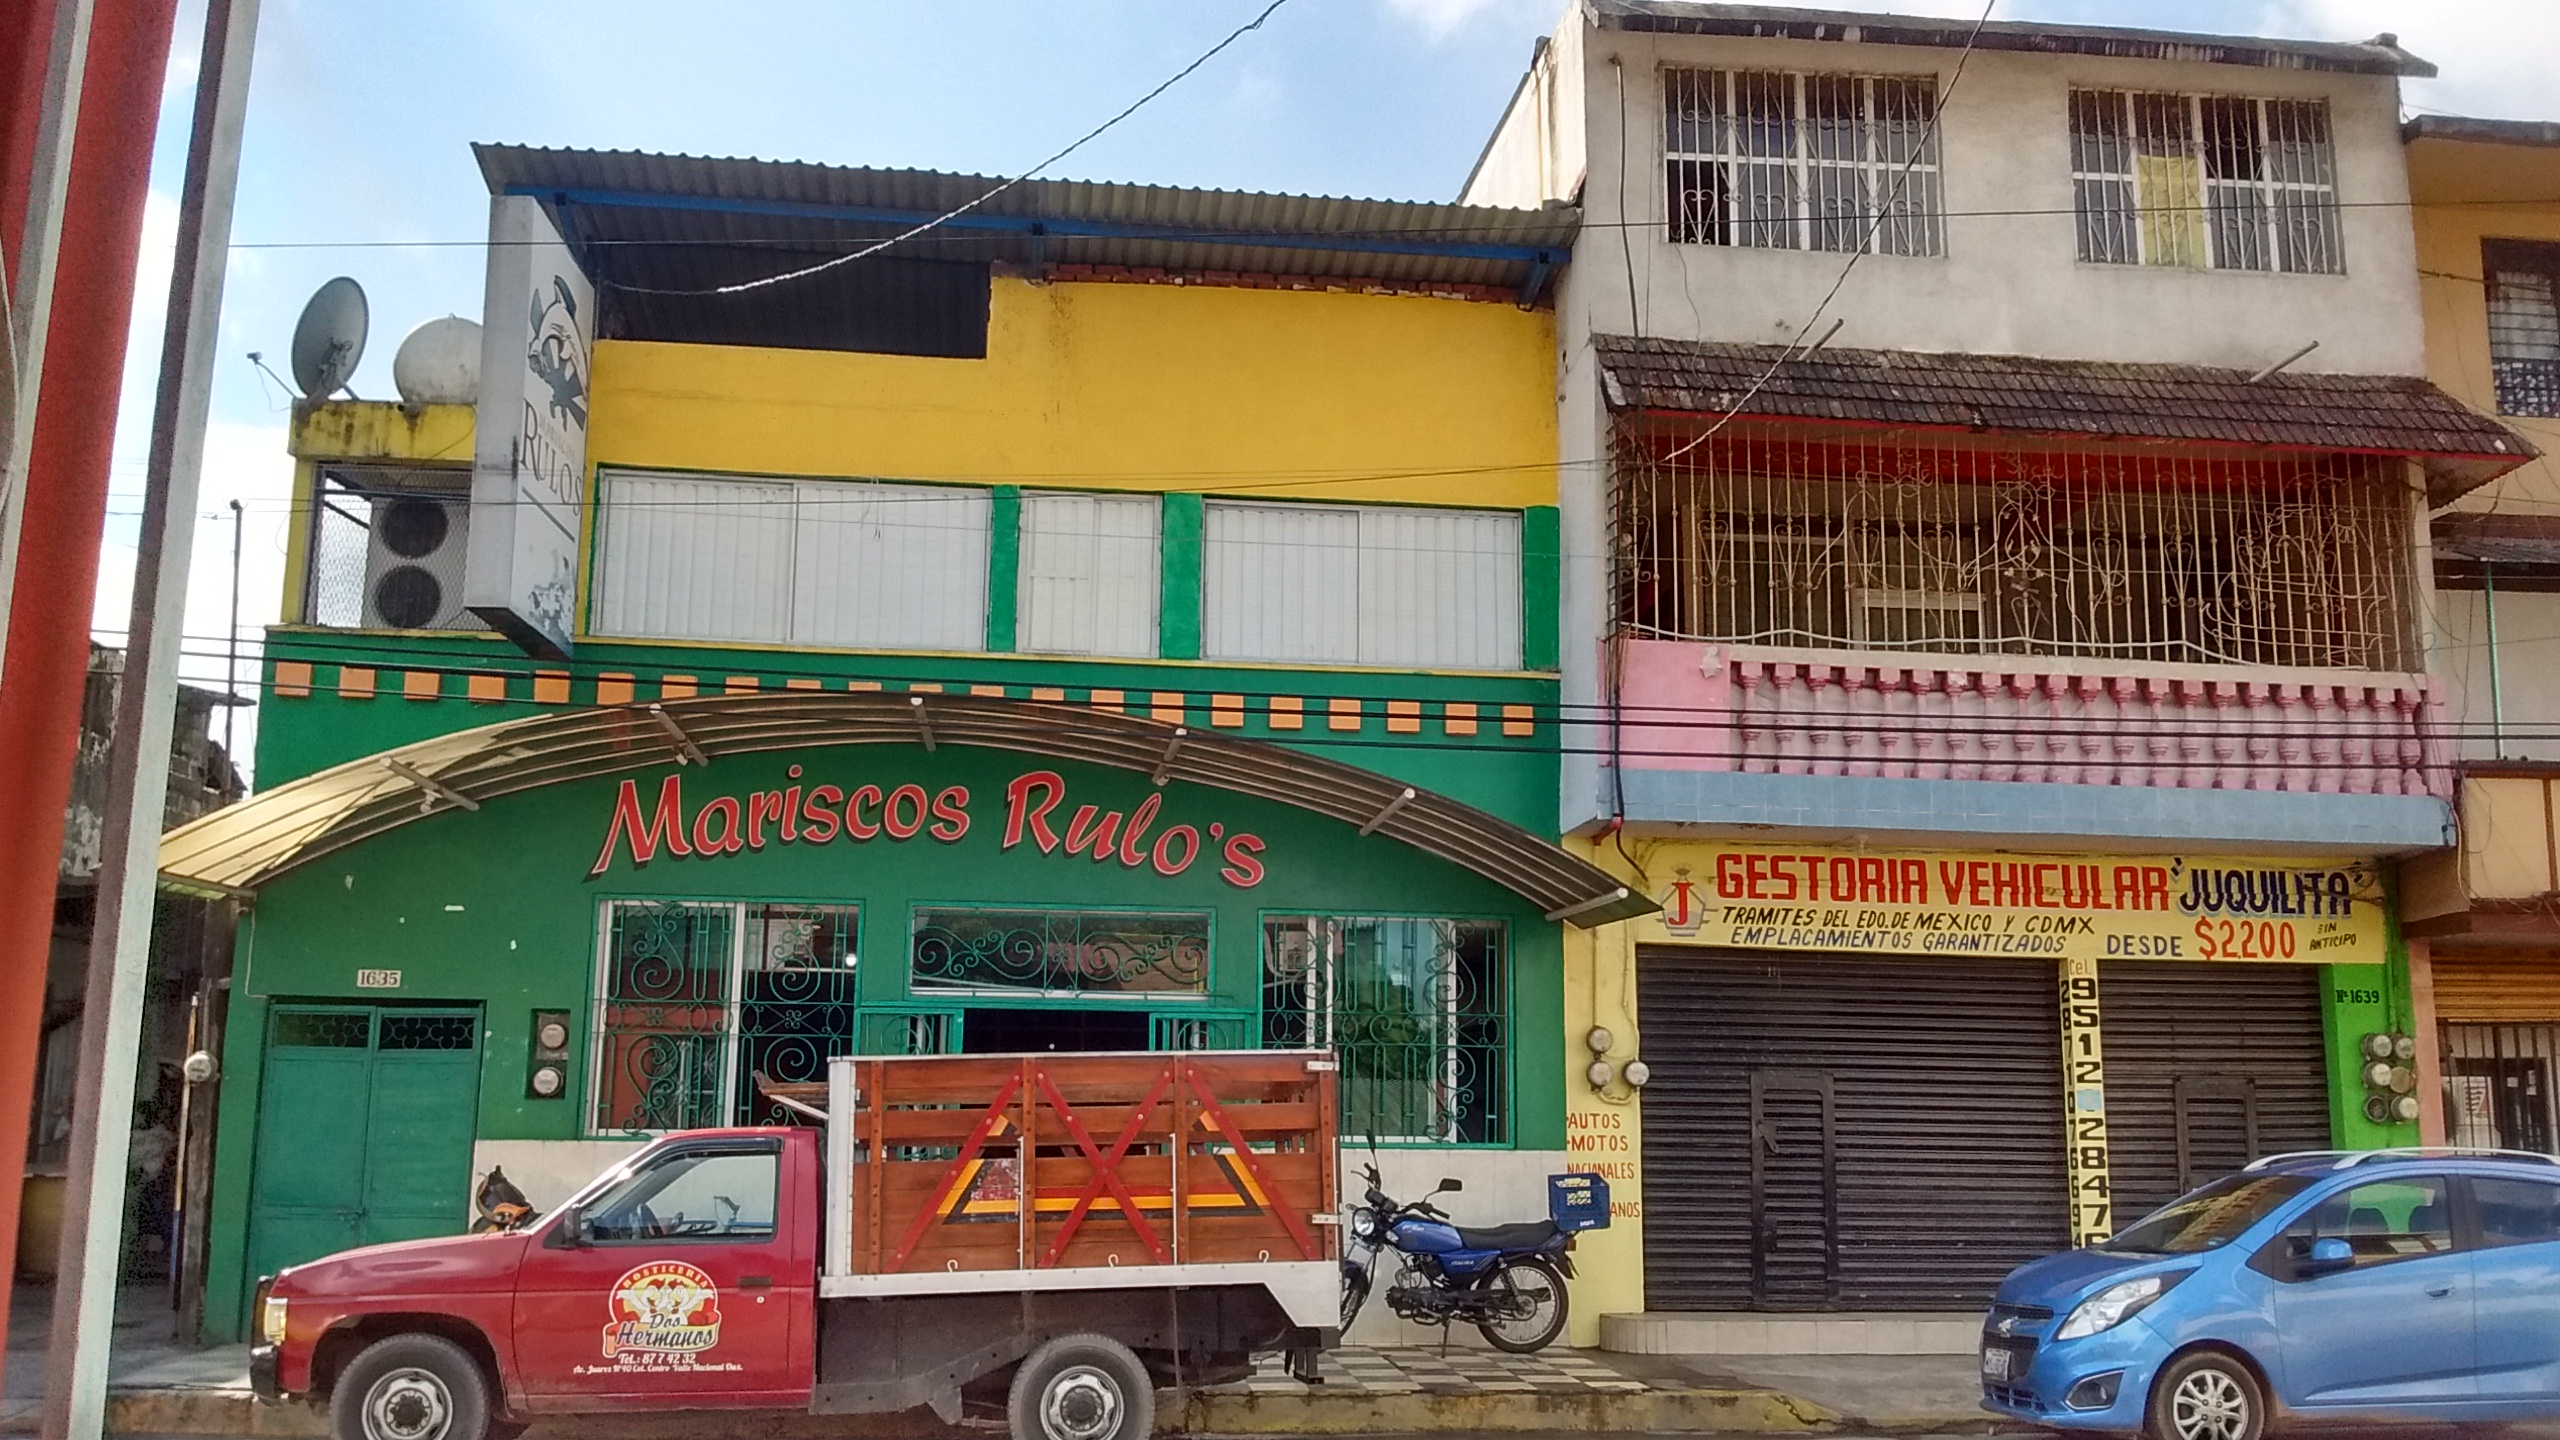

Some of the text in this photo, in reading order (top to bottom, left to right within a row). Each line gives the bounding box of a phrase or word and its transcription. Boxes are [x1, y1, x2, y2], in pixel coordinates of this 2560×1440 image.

[520, 398, 582, 517] RULOS
[589, 764, 1267, 888] Mariscos Rulo's
[1716, 853, 1928, 904] GESTORIA
[1939, 860, 2169, 911] VEHICULAR
[1721, 905, 1817, 926] TRAMITES
[1822, 909, 1850, 928] DEL
[1912, 912, 1992, 932] MEXICO
[2003, 914, 2015, 933] Y
[2024, 914, 2095, 935] CDMX
[1730, 926, 2067, 953] EMPLACAMIENTOS GARANTIZADOS
[2106, 934, 2183, 957] DESDE
[2308, 933, 2357, 951] ANTICIPO
[360, 970, 399, 986] 1635
[2350, 989, 2380, 1004] 1639
[1567, 1112, 1621, 1129] AUTOS
[1571, 1134, 1629, 1151] MOTOS
[649, 1312, 681, 1330] Dos
[617, 1322, 713, 1347] Hermanos
